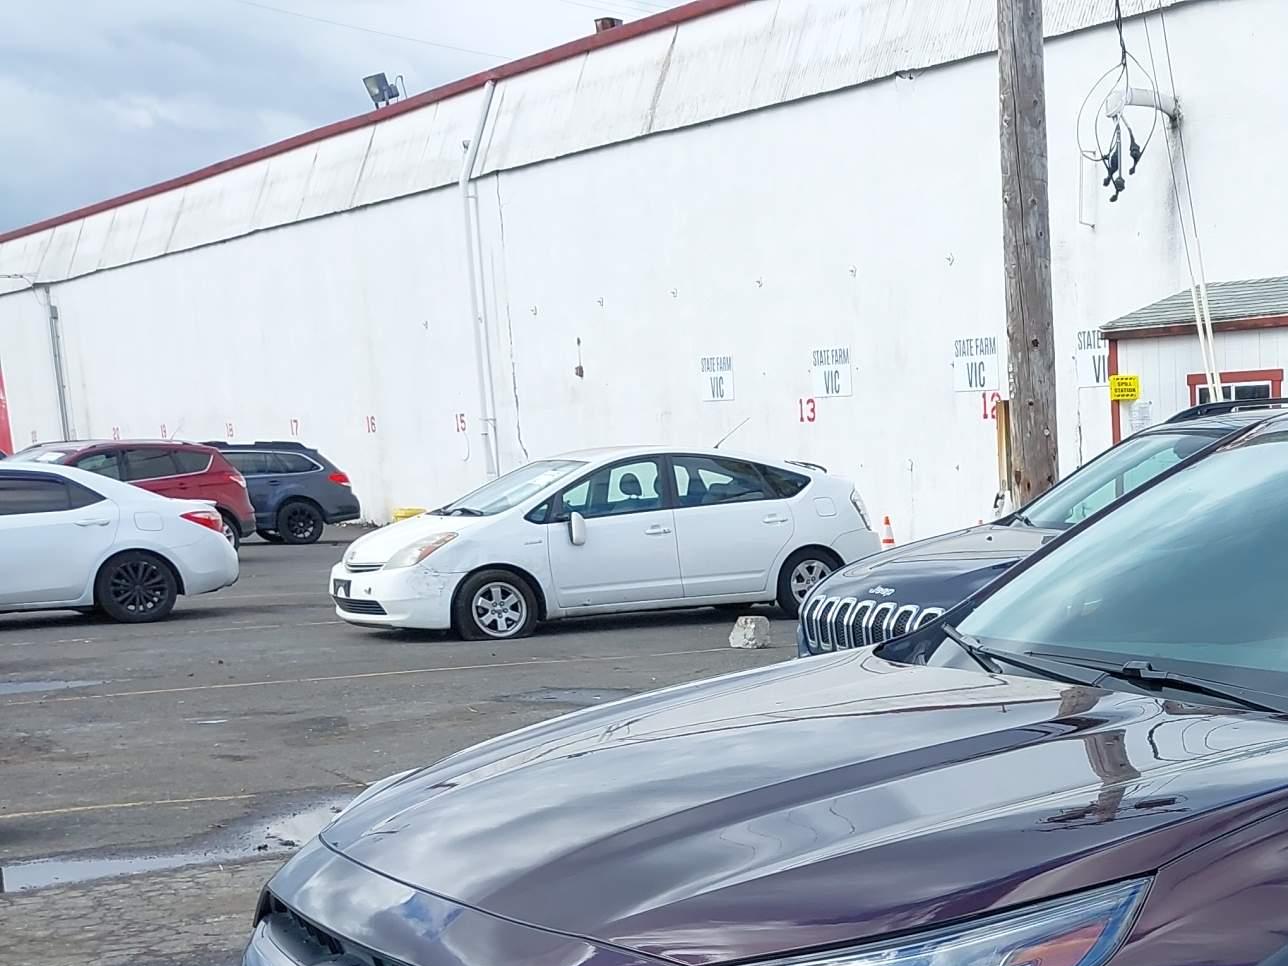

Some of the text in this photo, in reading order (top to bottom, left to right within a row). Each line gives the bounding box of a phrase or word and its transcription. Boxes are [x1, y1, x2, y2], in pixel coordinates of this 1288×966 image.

[812, 348, 850, 366] STATE FARM
[954, 336, 997, 357] STATE FARM
[701, 356, 732, 373] STATE FARM
[966, 361, 985, 388] VIC
[1092, 355, 1106, 383] VI
[710, 376, 725, 398] VIC
[824, 370, 841, 394] VIC
[799, 398, 816, 422] 13
[290, 419, 299, 436] 17
[366, 416, 377, 433] 16
[455, 413, 467, 432] 15
